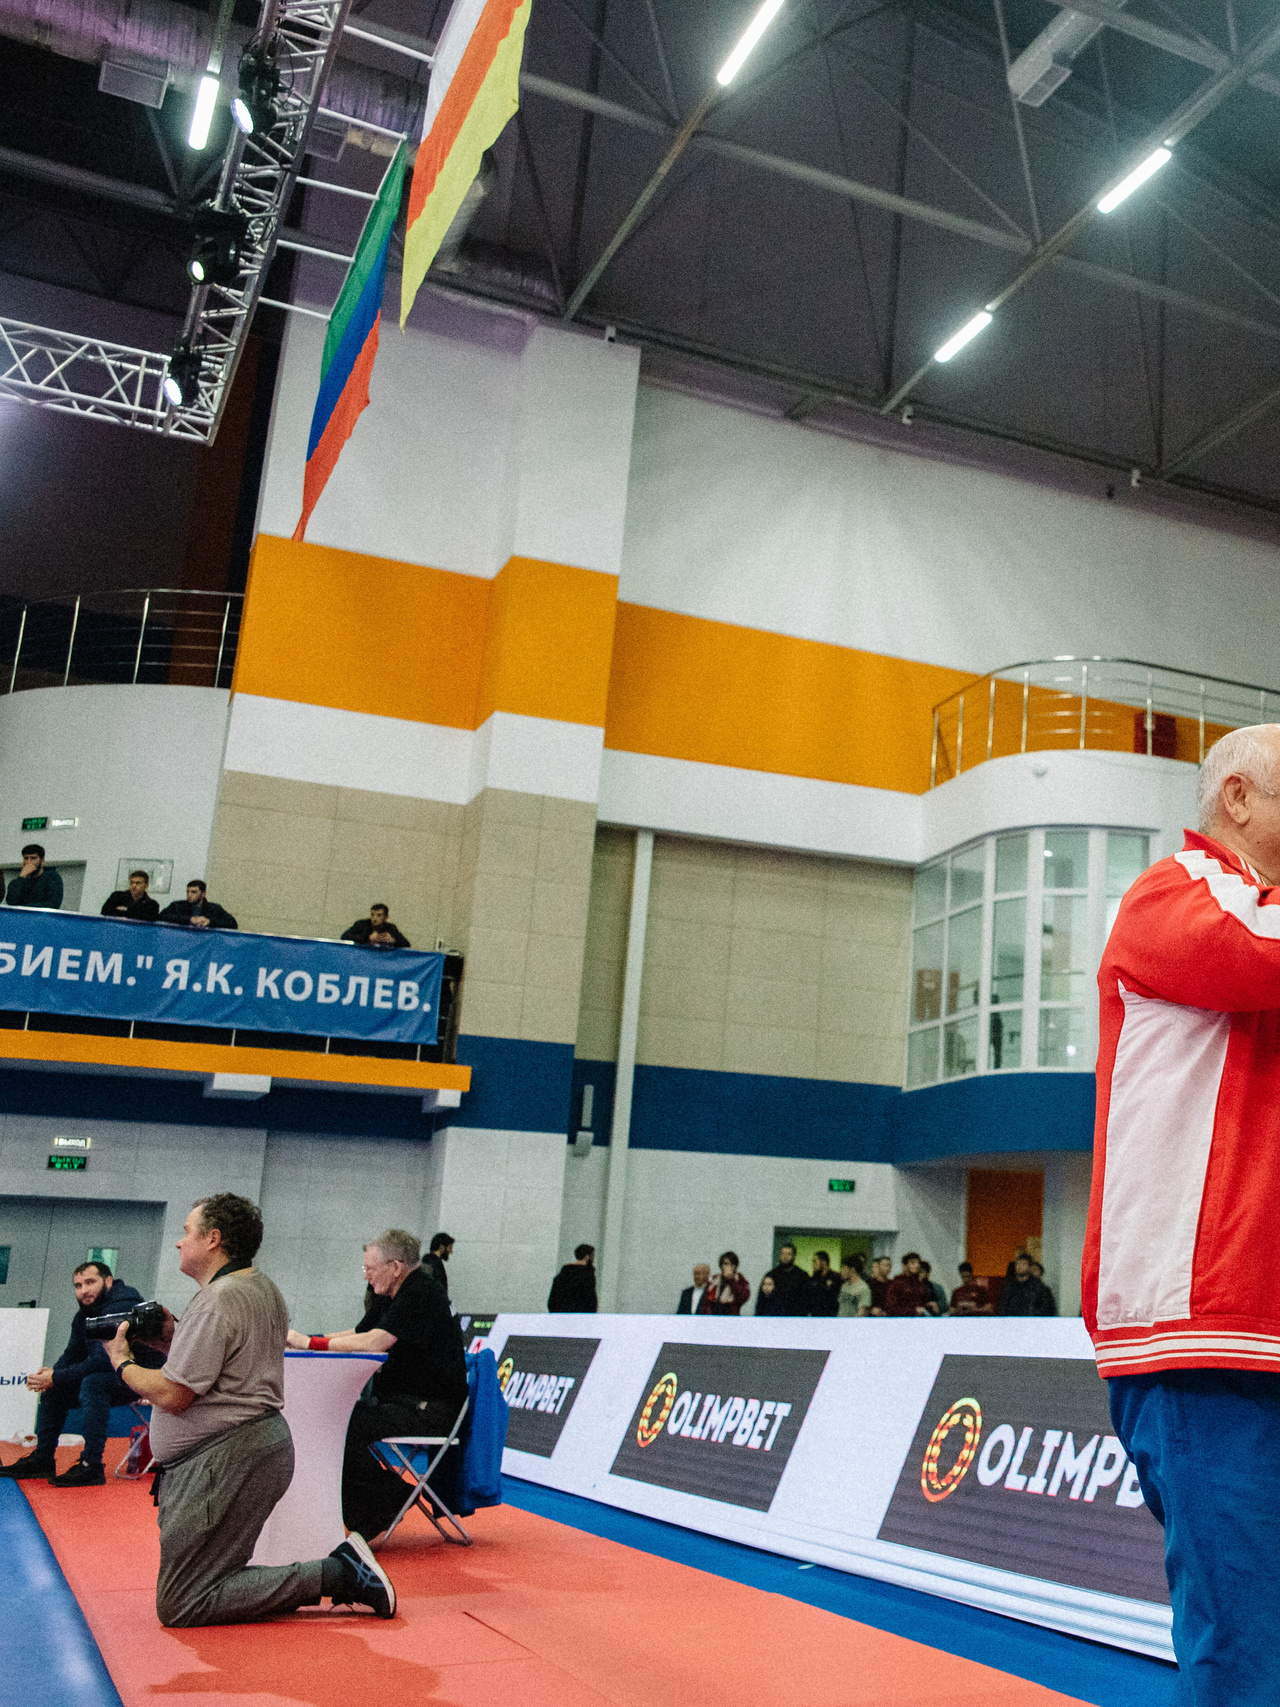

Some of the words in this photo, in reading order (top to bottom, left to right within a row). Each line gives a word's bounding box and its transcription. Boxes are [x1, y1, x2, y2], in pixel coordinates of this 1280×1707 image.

[0, 941, 154, 986] БИЕМ."
[161, 958, 244, 997] Я.К.
[256, 967, 431, 1012] КОБЛЕВ.
[503, 1370, 576, 1415] OLIMPBET
[667, 1390, 793, 1451] OLIMPBET
